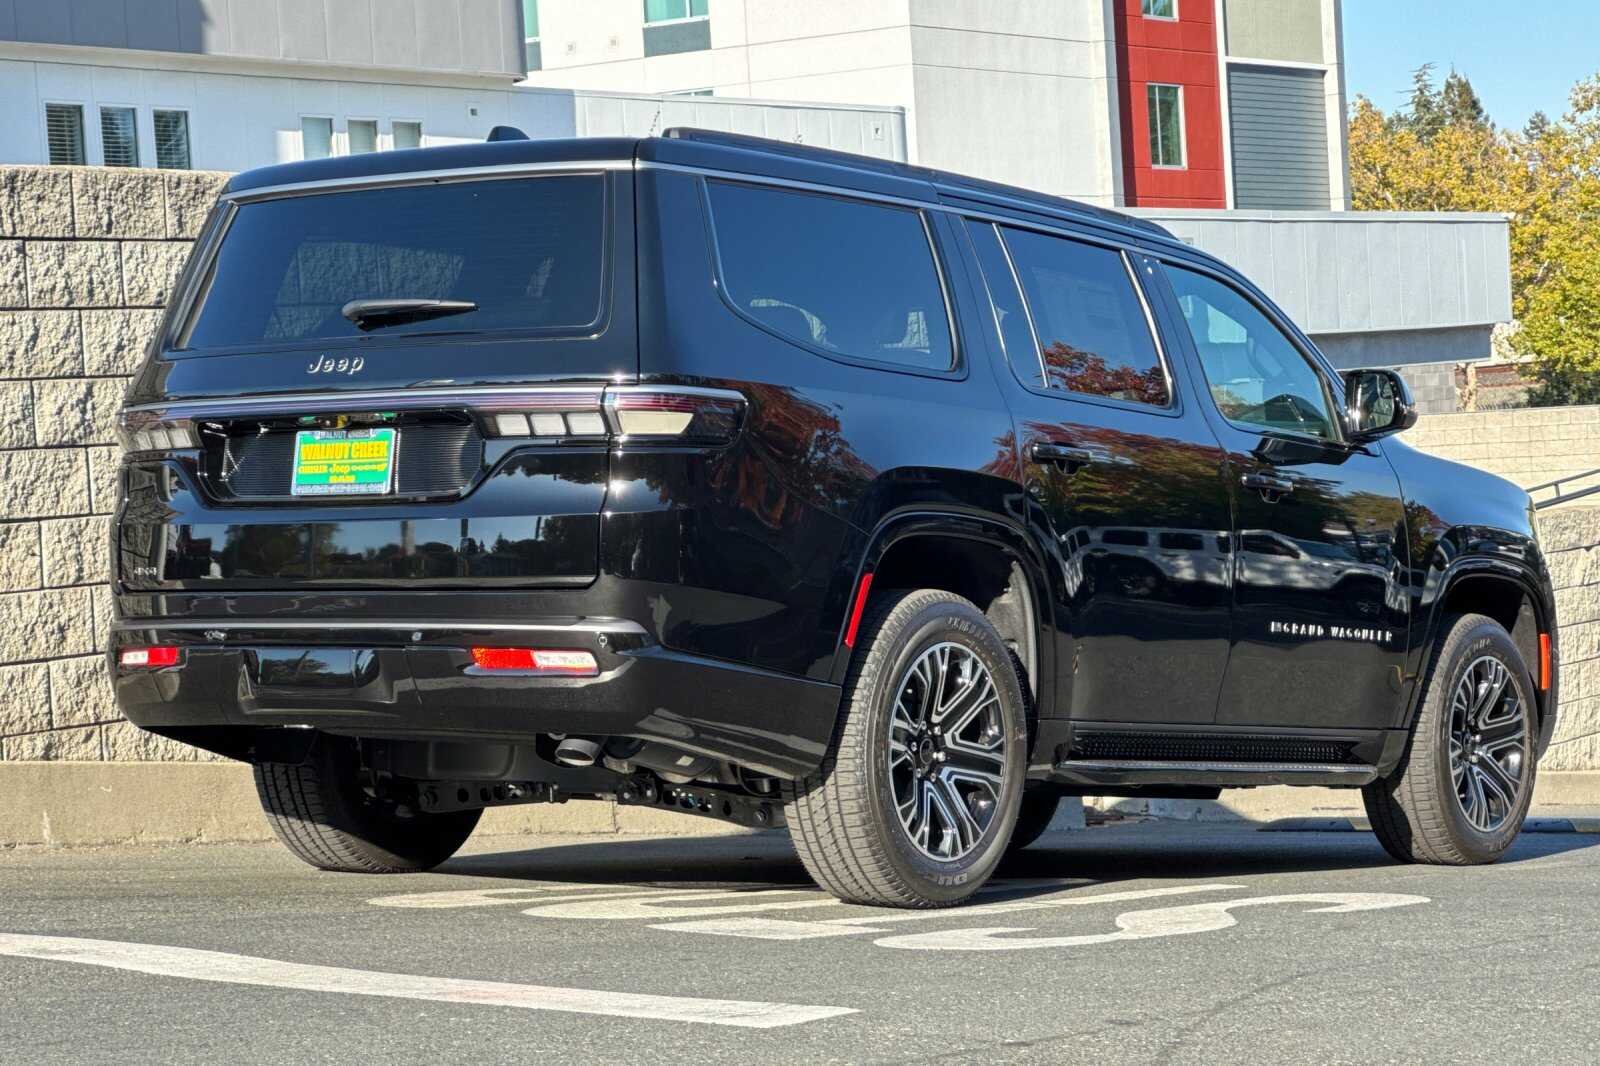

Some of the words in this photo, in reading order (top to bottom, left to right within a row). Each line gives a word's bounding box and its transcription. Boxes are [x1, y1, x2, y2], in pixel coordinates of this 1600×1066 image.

[307, 354, 364, 374] Jeep
[301, 443, 349, 459] WALNUT
[351, 441, 387, 458] CREEK
